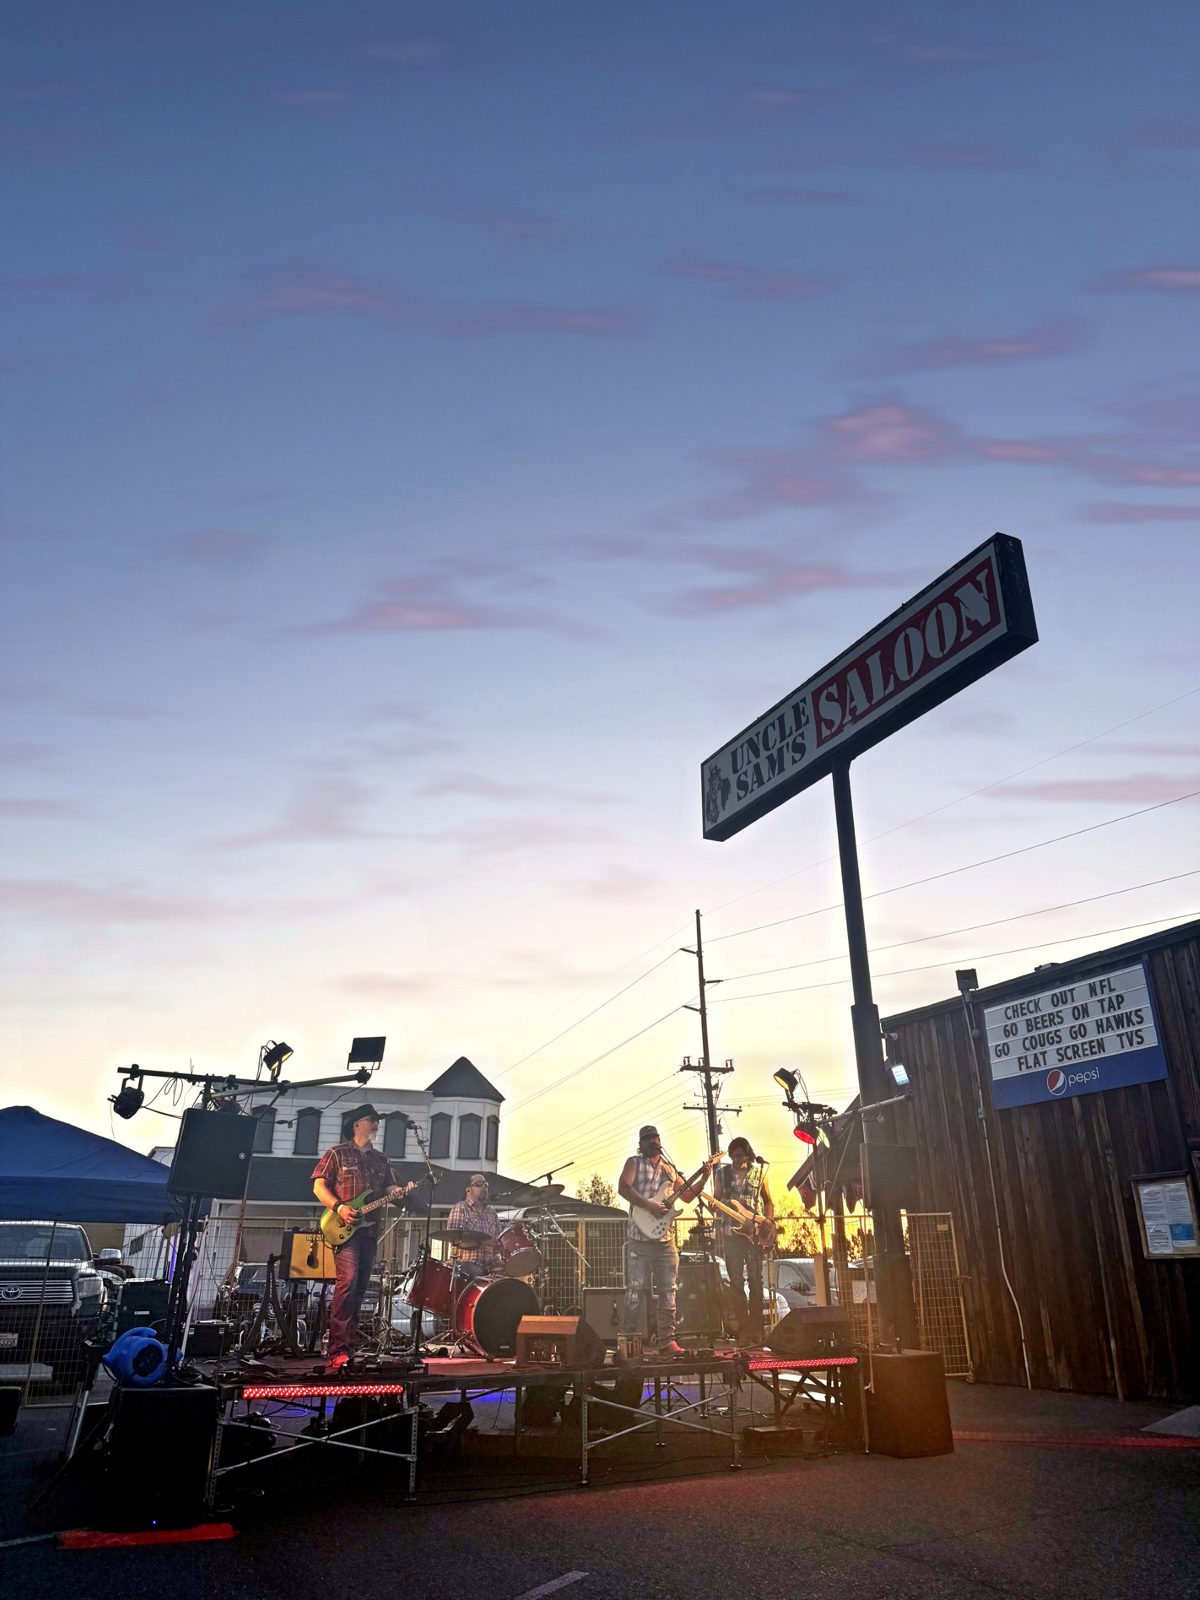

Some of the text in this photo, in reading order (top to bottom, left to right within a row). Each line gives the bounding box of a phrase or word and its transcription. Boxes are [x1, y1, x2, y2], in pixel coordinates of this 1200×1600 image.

[818, 569, 989, 739] SALOON
[731, 698, 808, 773] UNCLE
[735, 733, 806, 802] SAM'S
[1003, 994, 1125, 1038] 60 BEERS ON TAP
[1005, 978, 1116, 1020] CHECK OUT NFL
[995, 1009, 1144, 1058] GO COUGS GO HAWKS
[1018, 1029, 1144, 1071] FLAT SCREEN TVS
[1068, 1068, 1100, 1087] pepsi
